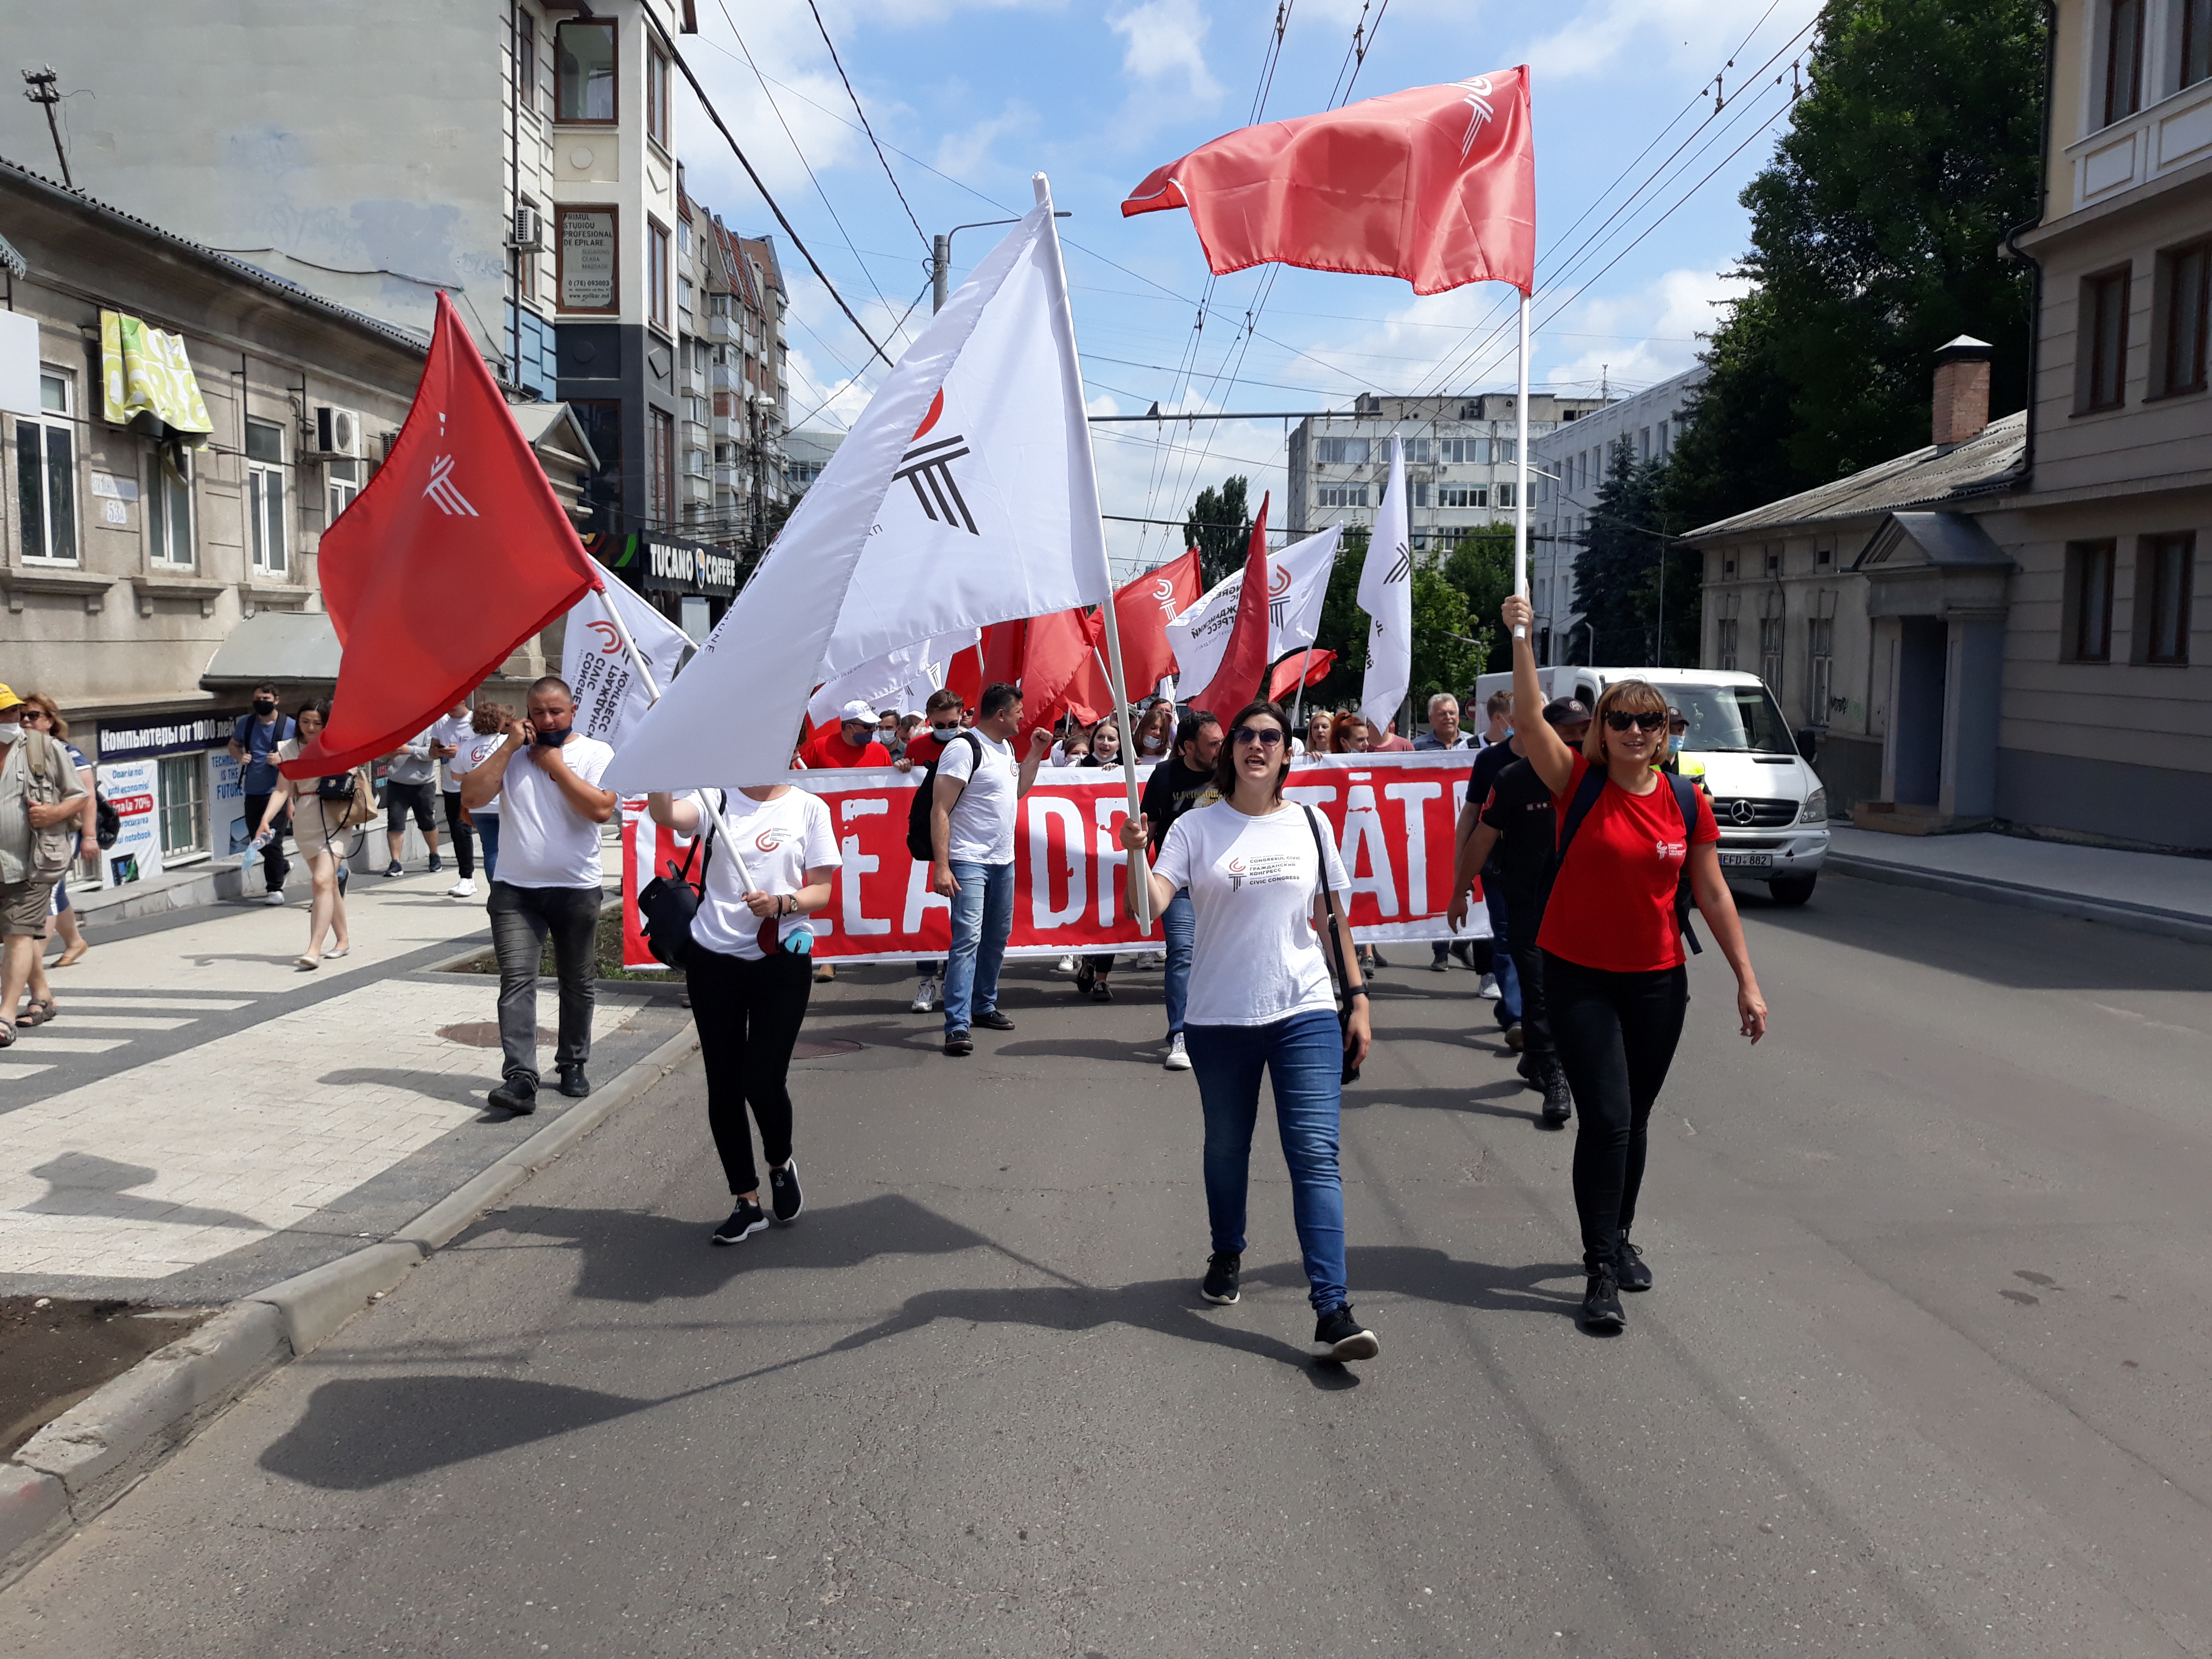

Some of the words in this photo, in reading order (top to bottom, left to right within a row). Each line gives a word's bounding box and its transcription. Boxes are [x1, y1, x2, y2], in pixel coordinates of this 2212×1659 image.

[650, 543, 694, 582] TUCANO
[706, 554, 736, 587] COFFEE
[100, 726, 178, 752] Компьютеры
[179, 724, 191, 743] от
[192, 718, 215, 741] 1000
[113, 769, 126, 779] Doar
[128, 767, 133, 777] la
[134, 766, 143, 776] noi
[221, 769, 226, 780] IS
[228, 767, 238, 780] THE
[125, 798, 133, 811] la
[134, 796, 151, 810] 70%
[124, 829, 151, 843] notebook
[1250, 862, 1296, 871] ГРАЖДАНСКИЙ
[1723, 855, 1742, 864] EFD
[1750, 855, 1767, 865] 882
[1250, 868, 1282, 876] КОНГРЕСС
